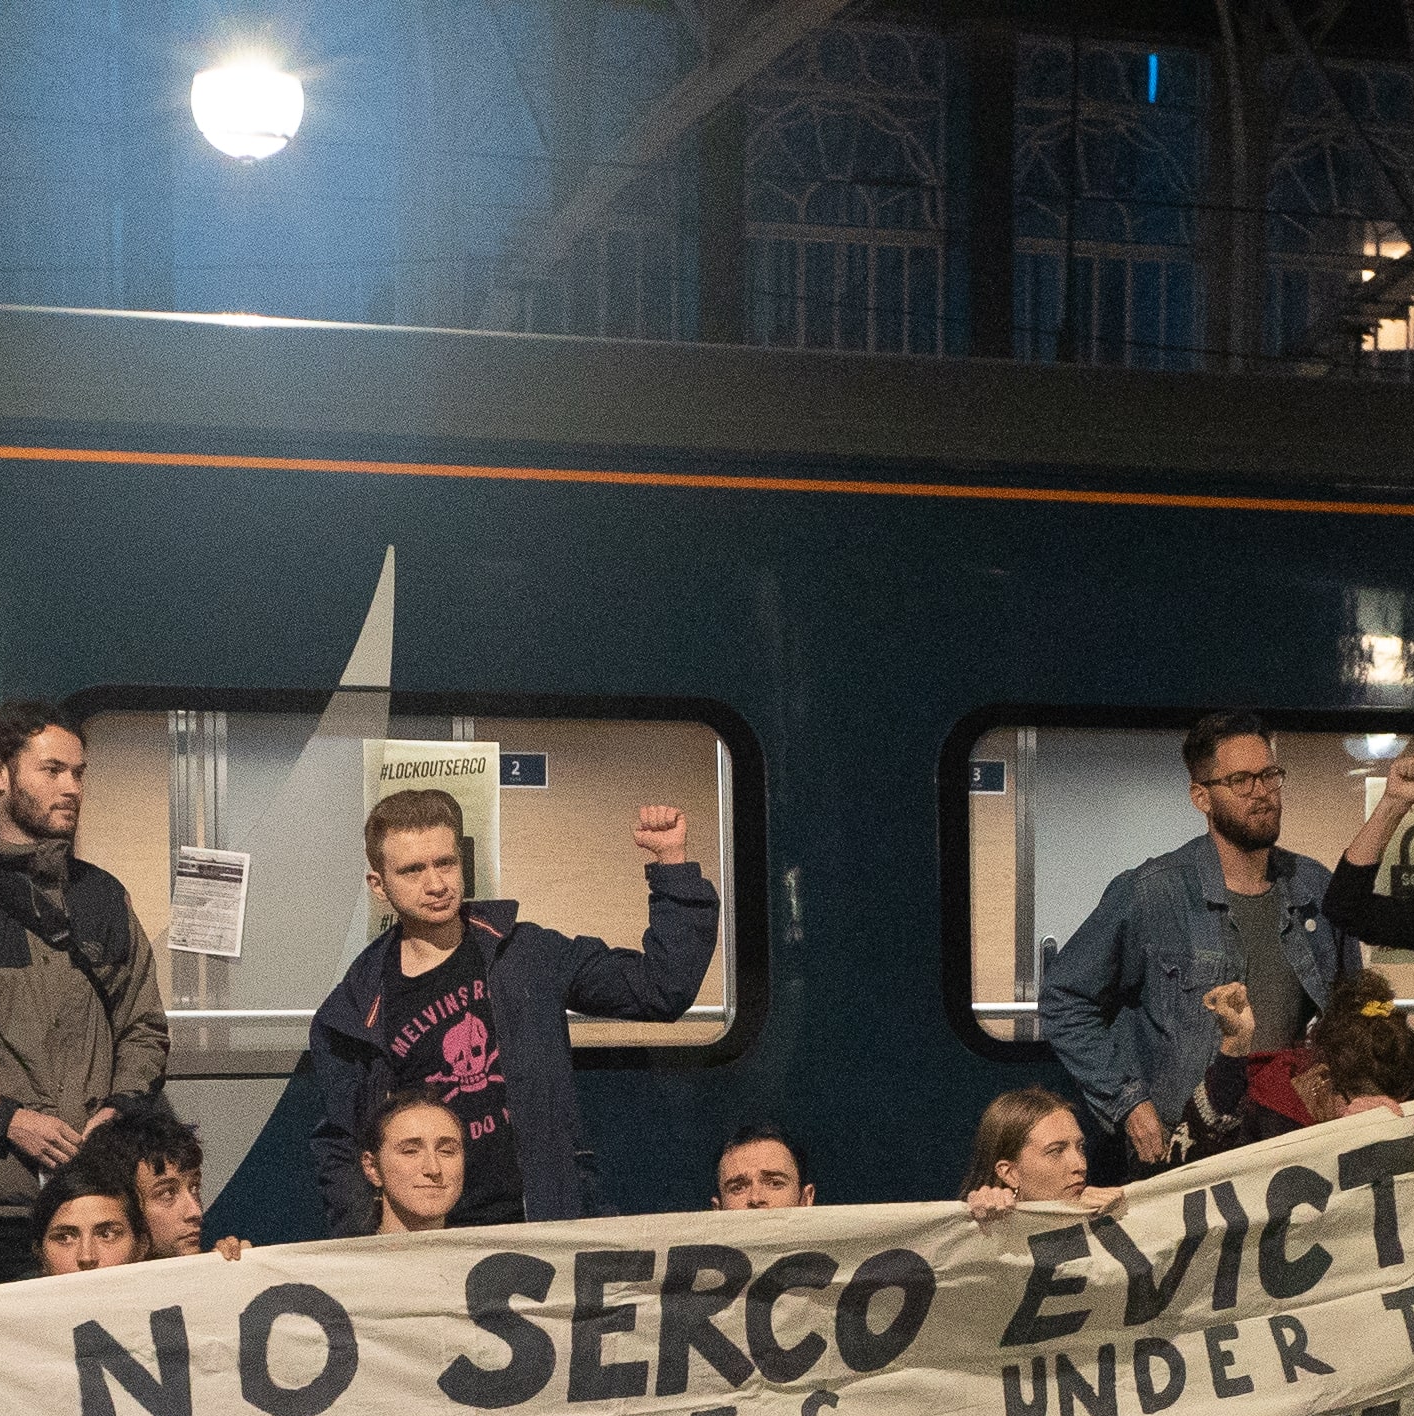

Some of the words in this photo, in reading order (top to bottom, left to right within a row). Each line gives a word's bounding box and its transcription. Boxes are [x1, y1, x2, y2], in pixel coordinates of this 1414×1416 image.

[380, 757, 487, 782] #LOCKOUTSERCO
[511, 760, 520, 776] 2
[973, 767, 981, 782] 3
[390, 986, 468, 1058] MELVINS
[437, 1244, 937, 1410] SERCO
